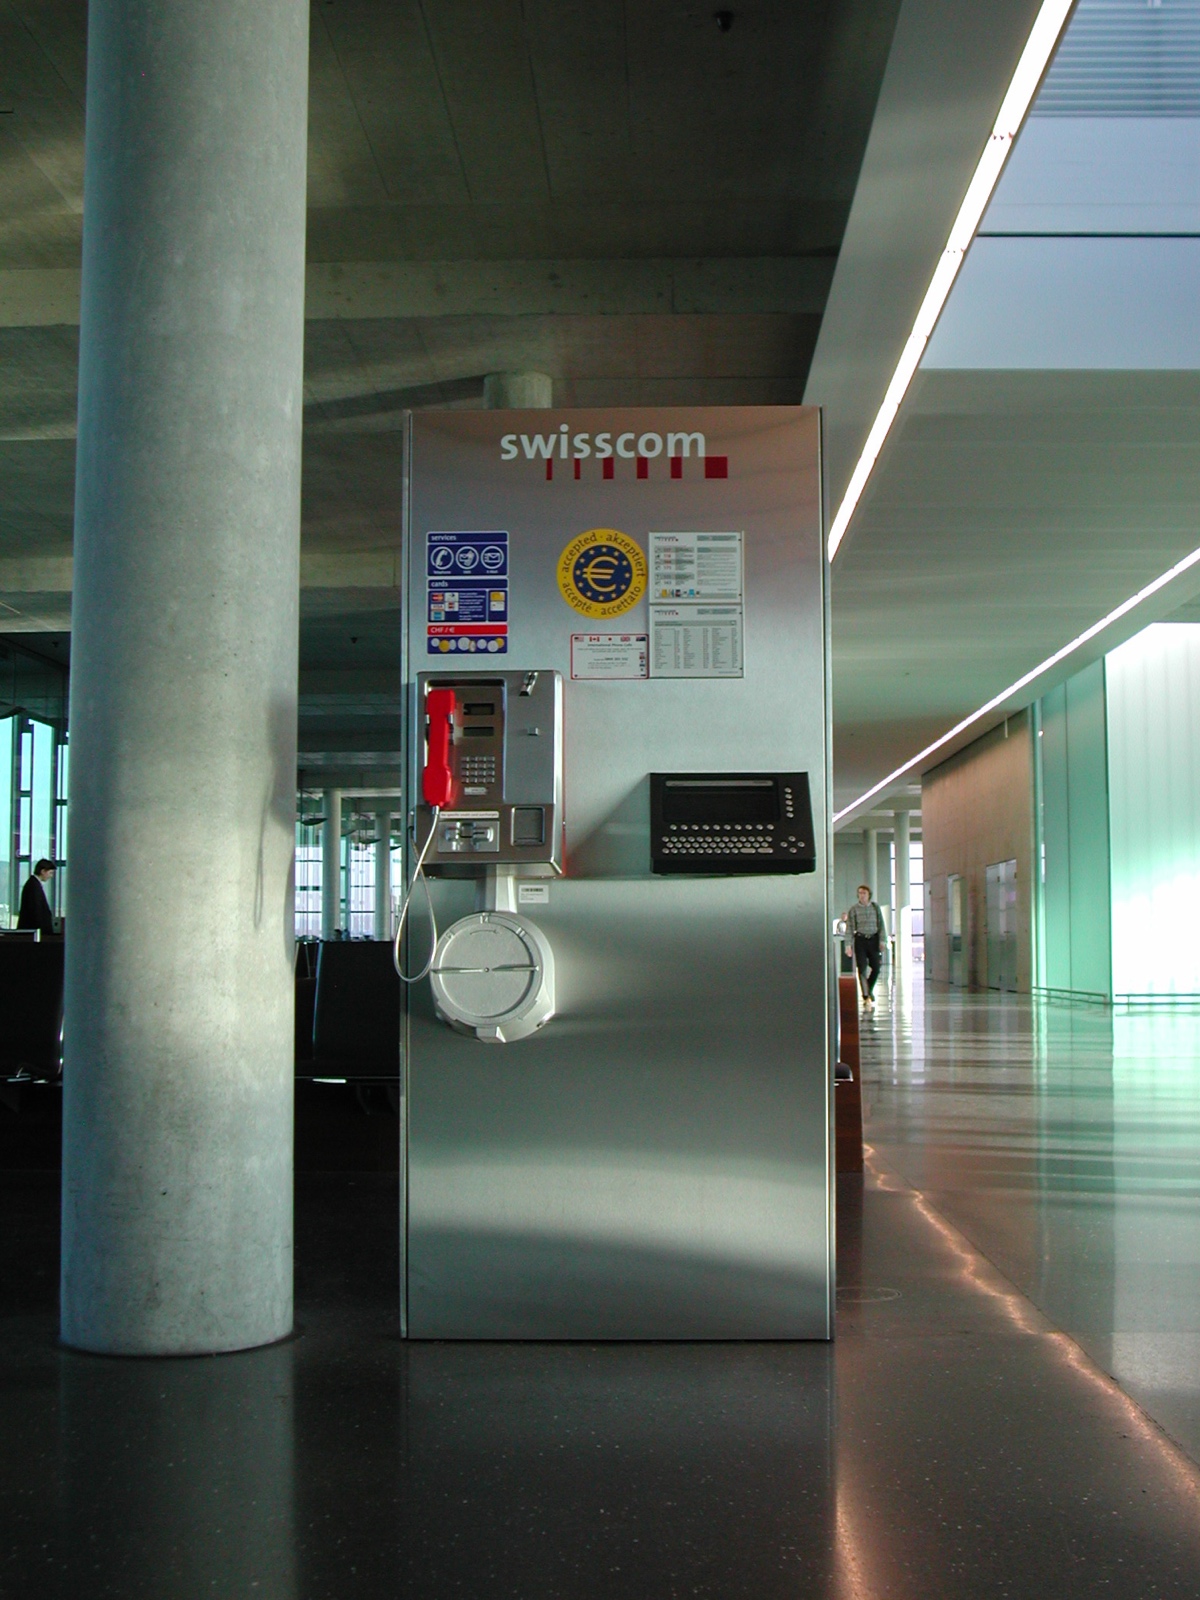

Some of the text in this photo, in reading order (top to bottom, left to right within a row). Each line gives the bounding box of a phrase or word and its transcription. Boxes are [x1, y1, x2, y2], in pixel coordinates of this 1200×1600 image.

[500, 423, 706, 460] swisscom
[562, 532, 598, 573] accepted
[605, 532, 646, 577] akzeptiert
[562, 582, 641, 615] accepté accettato
